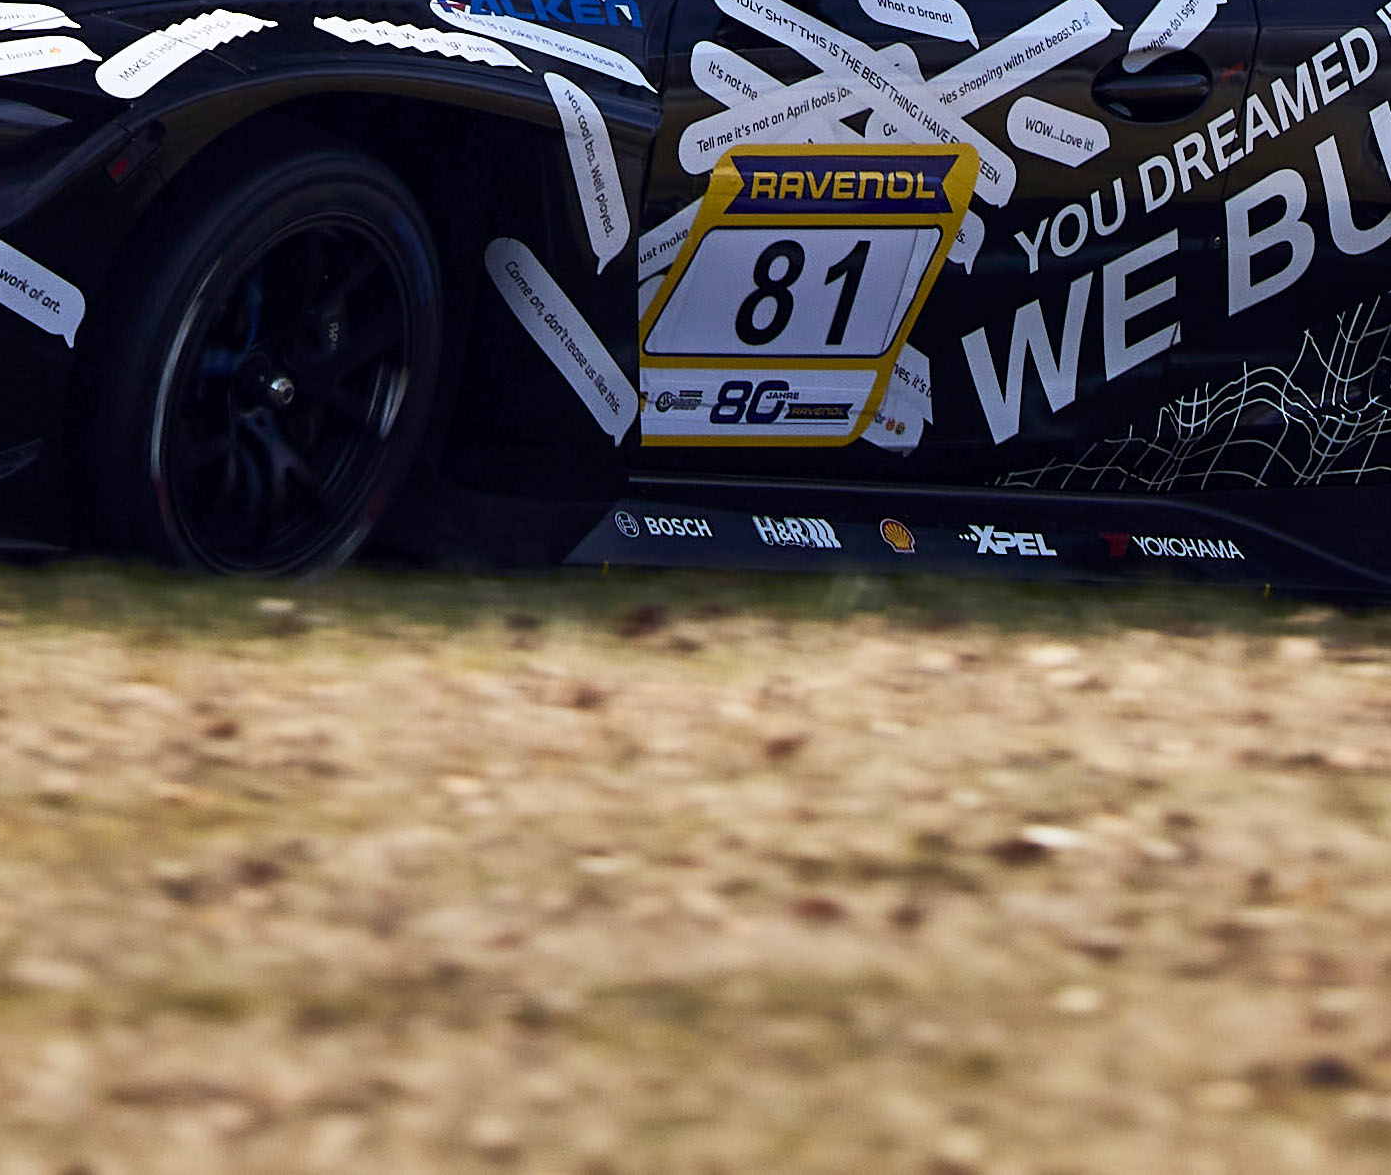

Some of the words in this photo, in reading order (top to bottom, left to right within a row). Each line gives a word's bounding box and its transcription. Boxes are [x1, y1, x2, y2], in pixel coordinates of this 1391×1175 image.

[916, 3, 954, 25] brand!
[118, 58, 152, 82] MAKE
[557, 42, 592, 61] gonna
[955, 65, 1004, 100] shopping
[1002, 51, 1025, 74] with
[1022, 39, 1046, 65] that
[1044, 26, 1074, 54] beast
[707, 59, 725, 81] It's
[722, 68, 743, 90] not
[740, 79, 759, 101] the
[796, 22, 828, 50] THIS
[838, 46, 864, 74] THE
[860, 65, 891, 94] BEST
[885, 81, 922, 120] THING
[921, 113, 952, 144] HAVE
[564, 88, 582, 115] Not
[577, 114, 593, 142] cool
[590, 163, 606, 193] Well
[696, 133, 717, 155] Tell
[715, 131, 734, 147] me
[732, 121, 751, 142] it's
[750, 117, 770, 137] not
[768, 111, 785, 128] an
[784, 98, 811, 123] April
[808, 91, 835, 113] fools
[1013, 179, 1130, 275] YOU
[1136, 26, 1379, 216] DREAMED
[749, 169, 938, 201] RAVENOL
[658, 227, 691, 254] make
[27, 284, 46, 303] of
[41, 292, 63, 316] art.
[734, 239, 872, 347] 81
[504, 259, 534, 299] Come
[529, 293, 547, 317] on,
[543, 310, 571, 343] don't
[564, 335, 589, 368] tease
[583, 363, 598, 382] us
[592, 374, 611, 398] like
[603, 389, 622, 416] this.
[960, 228, 1182, 446] WE
[709, 380, 790, 425] 80
[765, 391, 801, 401] JAHRE
[644, 516, 713, 539] BOSCH
[970, 524, 1058, 558] XPEL
[1131, 534, 1246, 561] YOKOHAMA
